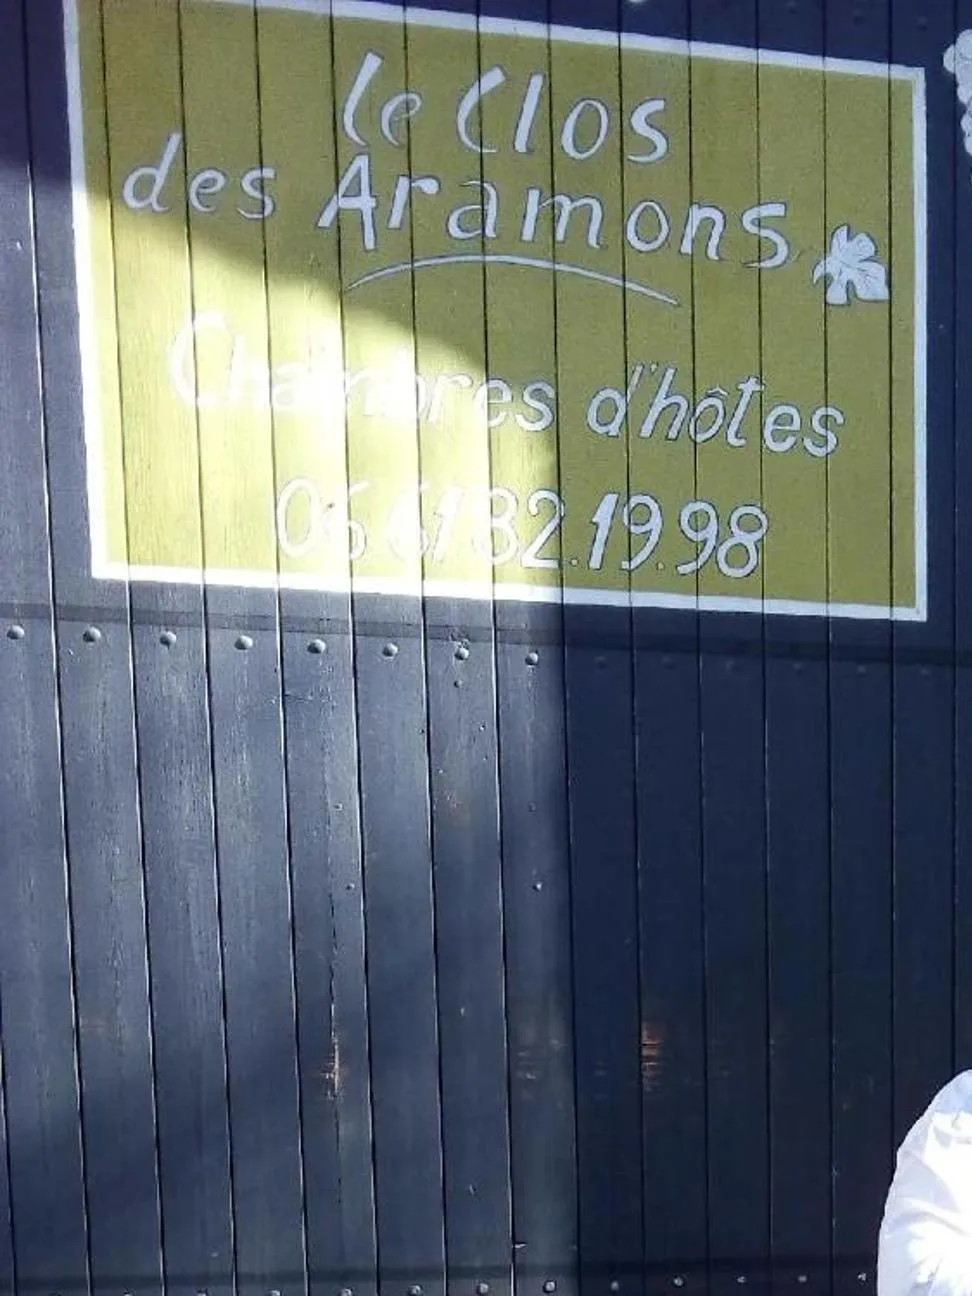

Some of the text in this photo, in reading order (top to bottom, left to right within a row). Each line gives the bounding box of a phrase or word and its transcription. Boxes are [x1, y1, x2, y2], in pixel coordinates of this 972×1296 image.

[343, 50, 669, 163] Le Clos
[121, 132, 793, 270] des Aramons
[586, 361, 845, 457] d'hôtes
